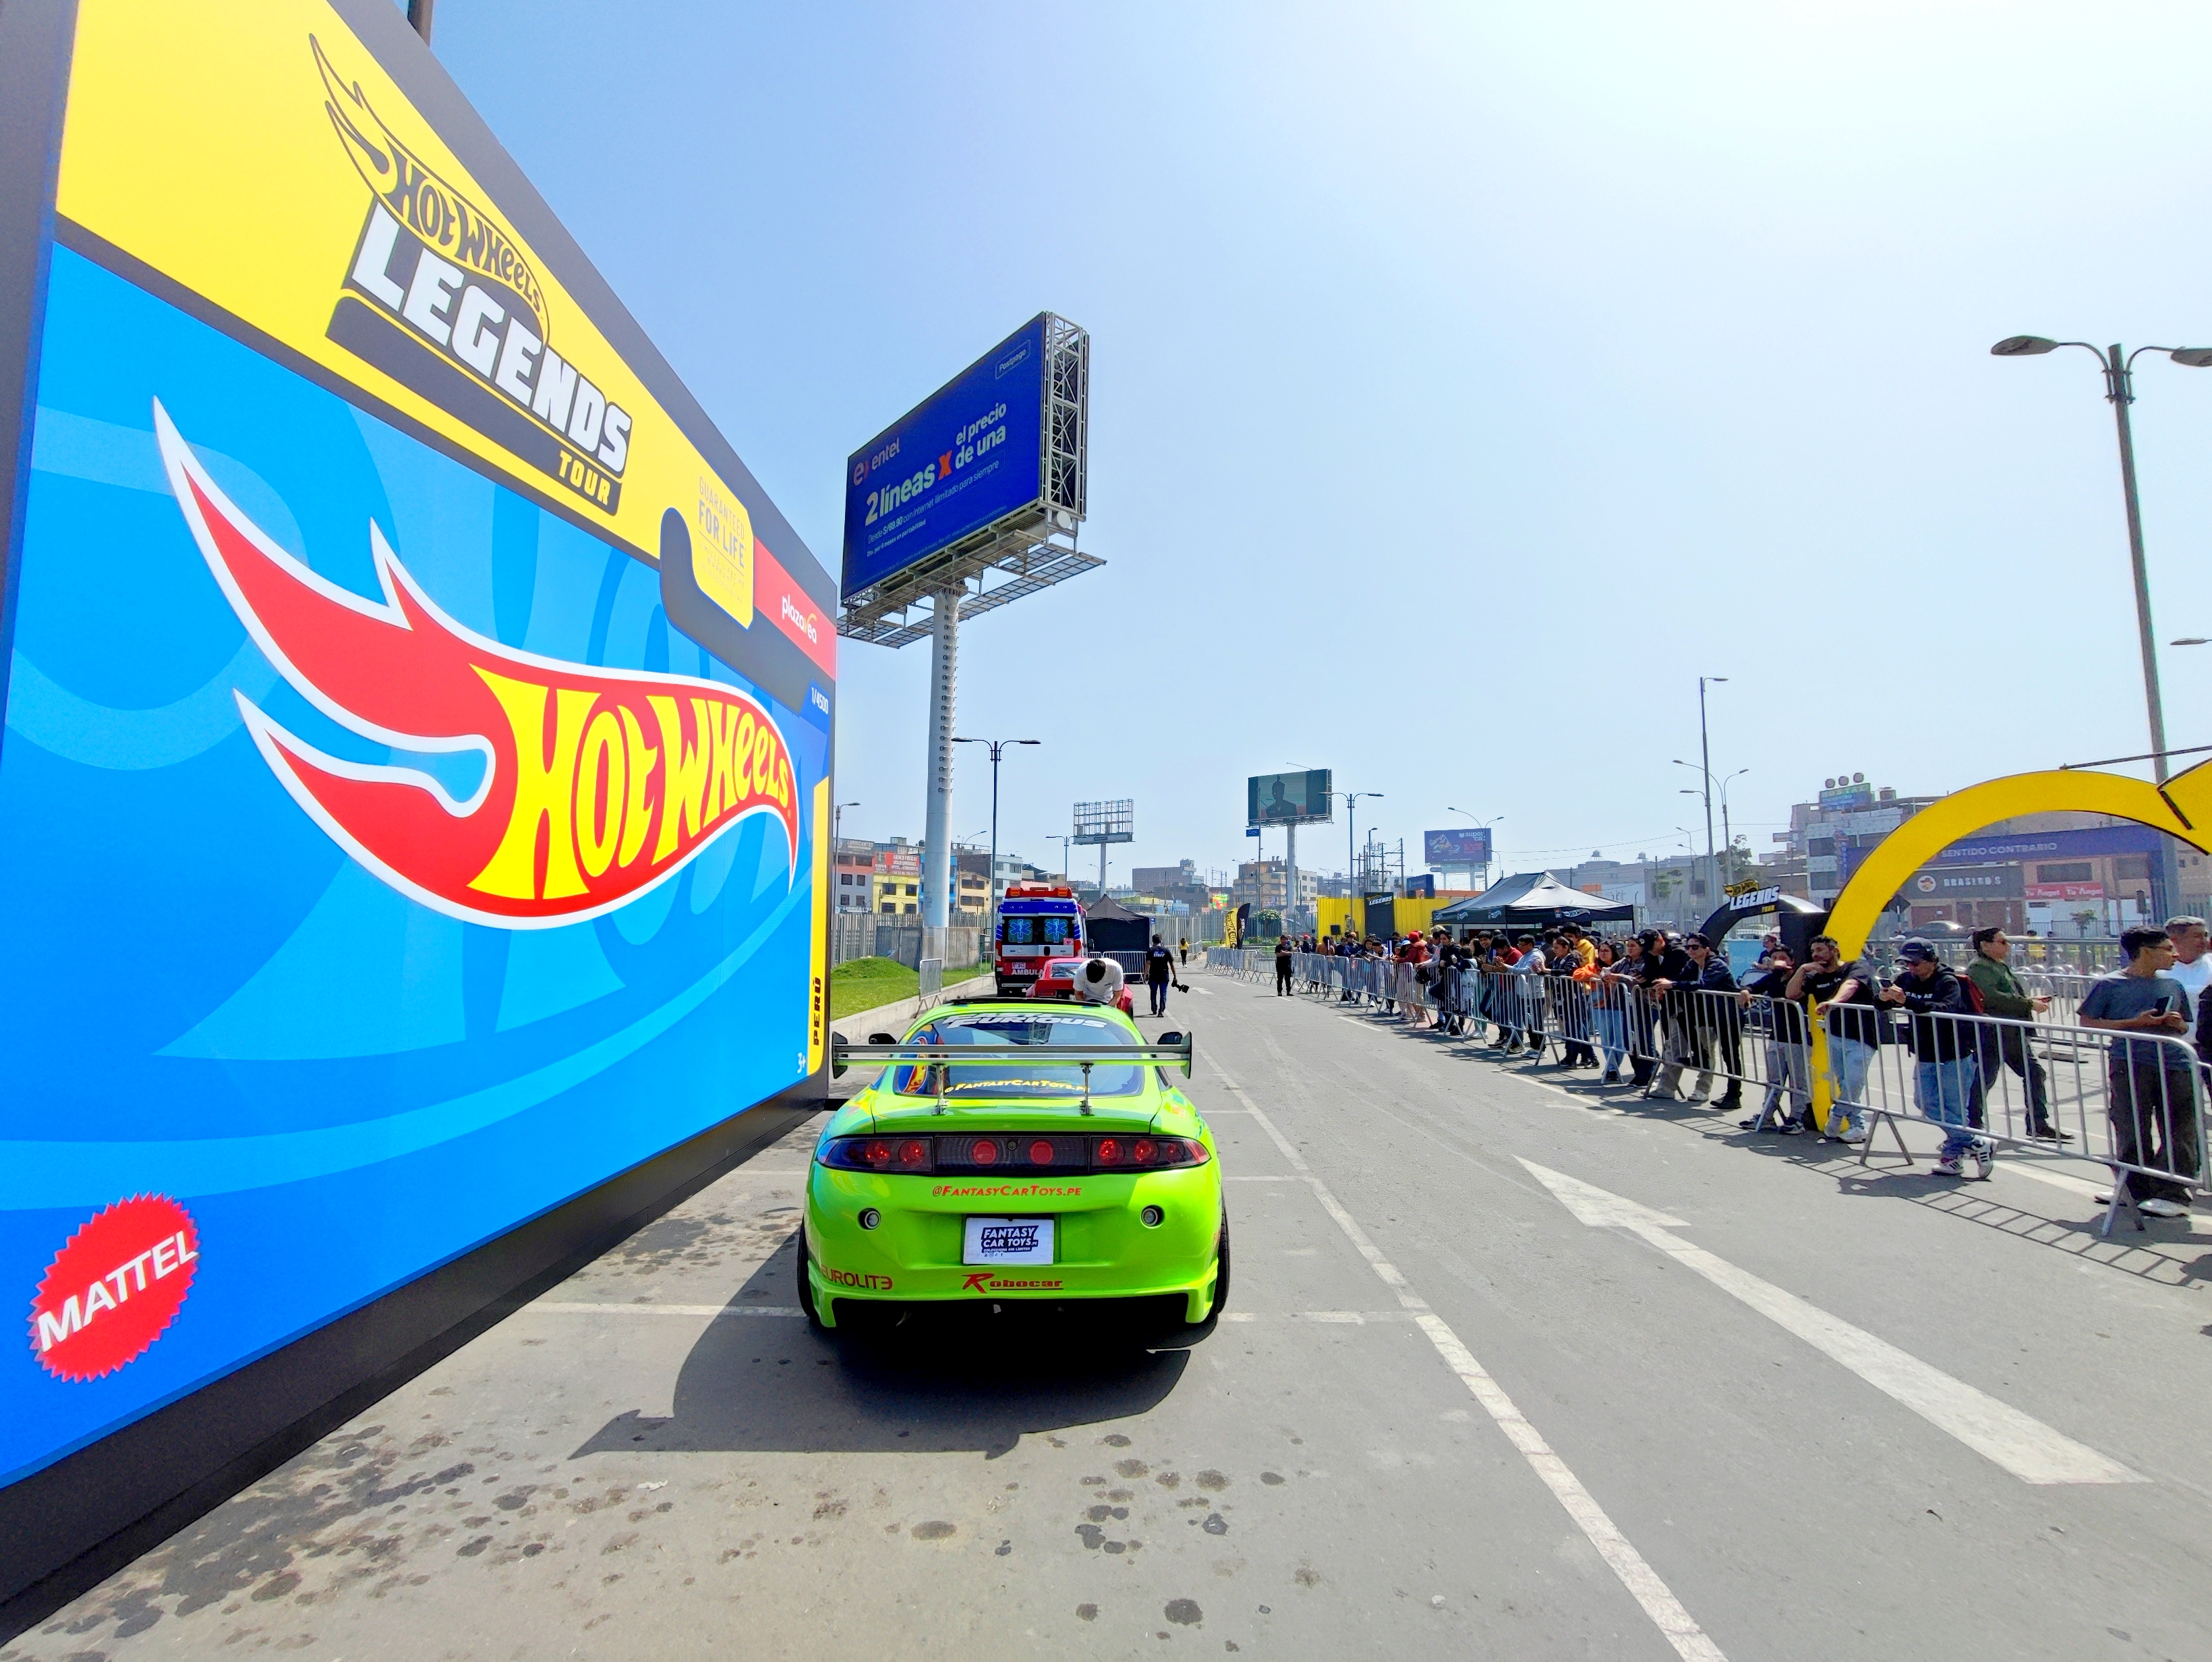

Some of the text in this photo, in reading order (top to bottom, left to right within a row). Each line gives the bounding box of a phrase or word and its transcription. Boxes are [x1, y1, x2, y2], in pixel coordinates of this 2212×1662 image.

[351, 201, 633, 472] LEGENDS
[999, 349, 1026, 372] Postpago
[956, 402, 1007, 446] el precio
[871, 437, 900, 470] entel
[955, 425, 1006, 469] de una
[558, 449, 610, 506] TOUR
[865, 491, 879, 527] 2
[879, 463, 935, 517] líneas
[699, 476, 745, 540] GUARANTEED
[868, 461, 999, 544] Desde S/69.90 con internet ilimitado para siempre
[699, 498, 720, 544] FOR
[723, 525, 745, 569] LIFE
[811, 687, 829, 714] 1/4500
[1942, 842, 2057, 857] SENTIDO CONTRARIO
[1369, 896, 1393, 906] LEGENDS
[1729, 886, 1780, 911] LEGENDS
[813, 977, 821, 1045] PERÚ
[946, 1016, 1107, 1029] FURIOUS
[983, 1227, 1036, 1238] FANTASY
[983, 1239, 1005, 1247] CAR
[37, 1230, 199, 1352] MATTEL
